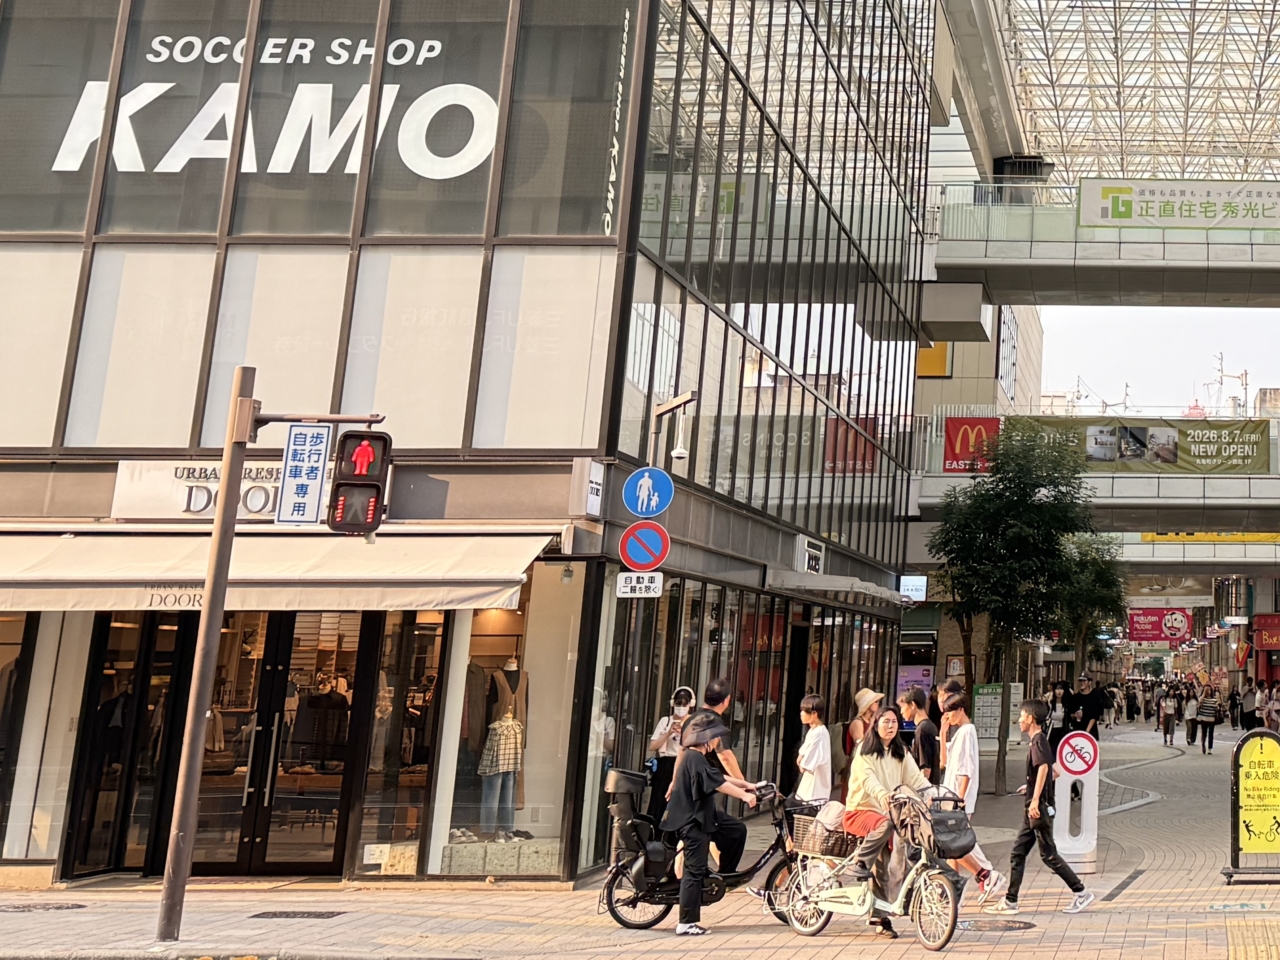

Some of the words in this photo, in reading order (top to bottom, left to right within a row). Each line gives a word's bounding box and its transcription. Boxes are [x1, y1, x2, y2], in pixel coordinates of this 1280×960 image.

[325, 38, 442, 66] SHOP
[51, 80, 500, 180] KAMO
[288, 432, 308, 480] 自転車
[304, 432, 325, 481] 歩行者
[1190, 444, 1217, 456] NEW
[1221, 444, 1257, 457] OPEN!
[174, 467, 222, 481] URBA
[291, 483, 310, 516] 専用
[624, 576, 656, 584] 自動車
[147, 593, 203, 607] DOOR
[1248, 760, 1275, 769] 自転車
